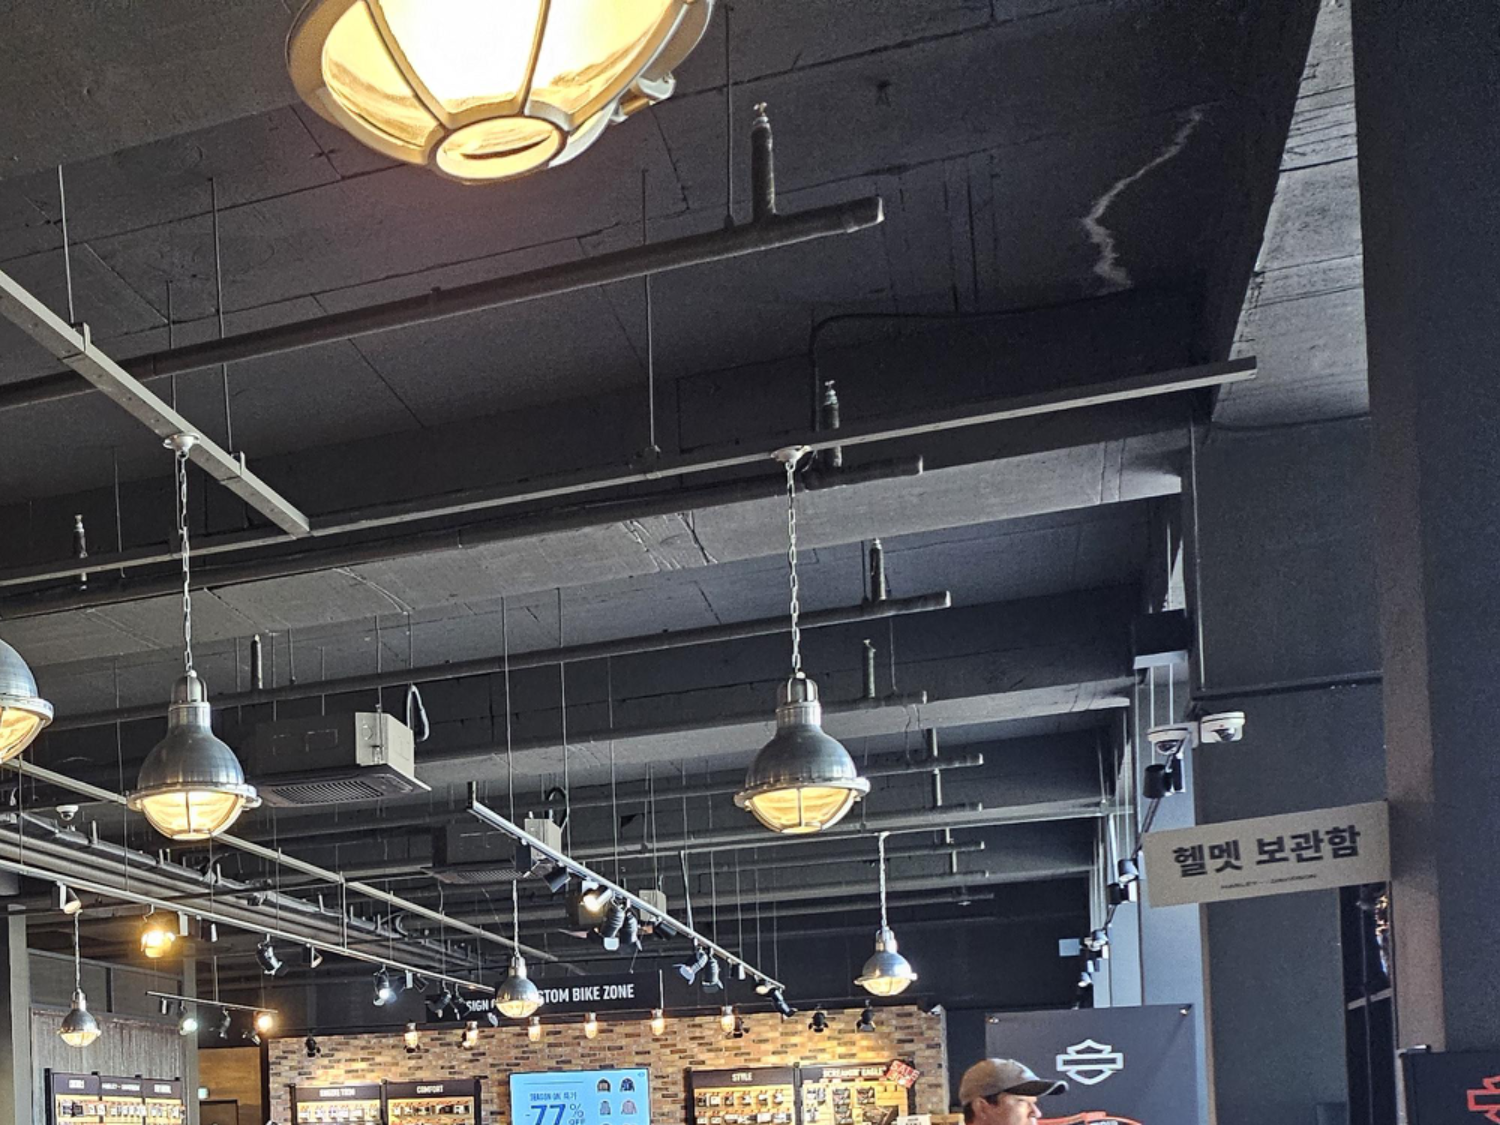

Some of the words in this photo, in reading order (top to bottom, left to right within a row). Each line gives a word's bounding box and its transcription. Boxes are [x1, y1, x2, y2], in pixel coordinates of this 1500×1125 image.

[1172, 840, 1243, 878] 헬멧
[1256, 824, 1361, 866] 보관함
[465, 1000, 489, 1012] SIGN
[537, 987, 569, 1006] STOM
[572, 986, 600, 1002] BIKE
[602, 984, 635, 1000] ZONE
[731, 1072, 754, 1082] STYLE
